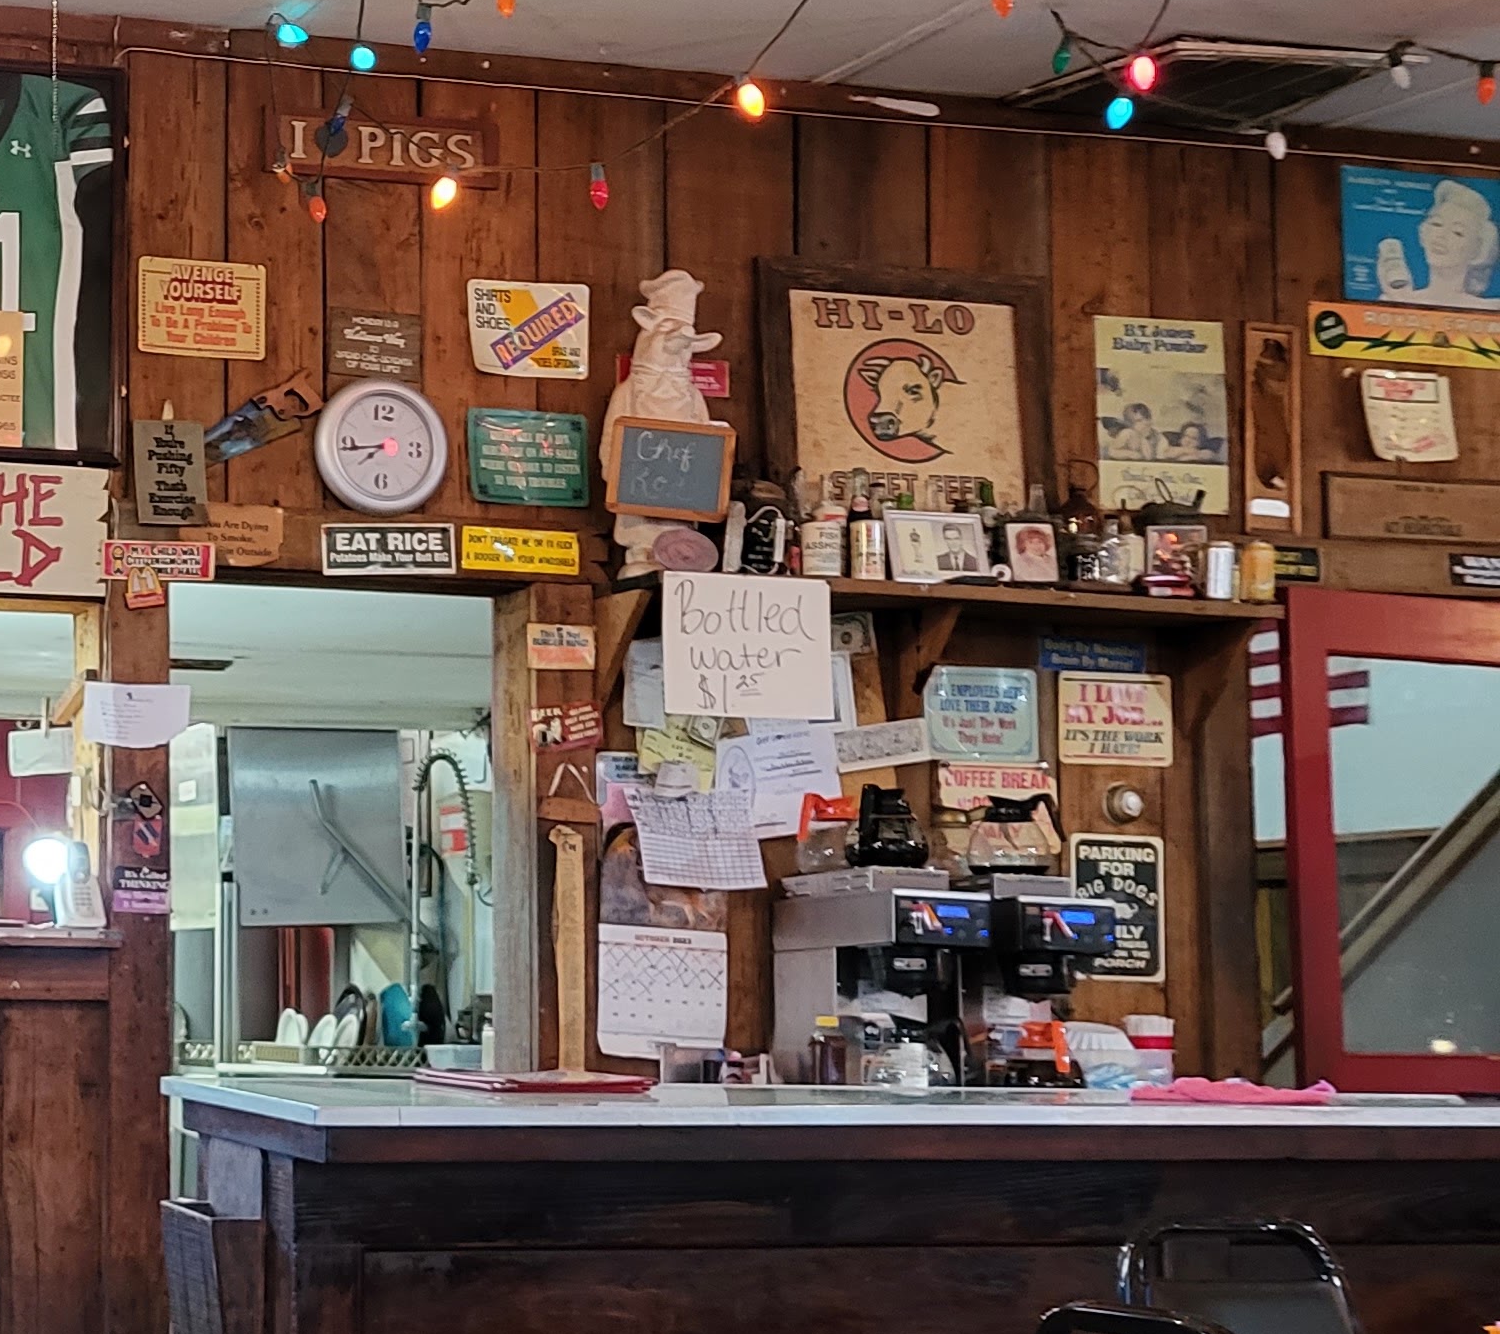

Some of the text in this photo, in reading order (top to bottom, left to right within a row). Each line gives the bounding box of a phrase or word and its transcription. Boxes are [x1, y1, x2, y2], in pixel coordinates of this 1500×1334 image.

[290, 121, 475, 169] I PIGS
[170, 264, 234, 285] AVENGE
[160, 279, 242, 305] YOURSELF
[474, 287, 512, 303] SHIRTS
[475, 302, 496, 316] AND
[811, 296, 975, 335] HI-LO
[475, 315, 512, 331] SHOES
[495, 300, 578, 364] REQUIRED
[373, 404, 395, 422] 12
[341, 435, 422, 458] 9 3
[147, 449, 194, 466] Pushing
[156, 462, 186, 478] Fifty
[373, 472, 388, 490] 6
[148, 492, 197, 504] Exercise
[334, 532, 444, 551] EAT RICE
[150, 547, 178, 556] CHILD
[368, 552, 392, 563] Make
[393, 552, 414, 563] Your
[674, 578, 816, 641] Bottled
[689, 643, 802, 671] water
[1079, 684, 1088, 703] I
[1063, 705, 1095, 725] MY
[1092, 730, 1163, 744] THE WORK
[944, 768, 996, 788] COFFEE
[1078, 845, 1156, 863] PARKING
[1098, 861, 1136, 878] FOR
[1076, 876, 1159, 907] BIG DOGS
[1093, 957, 1147, 968] PORCH
